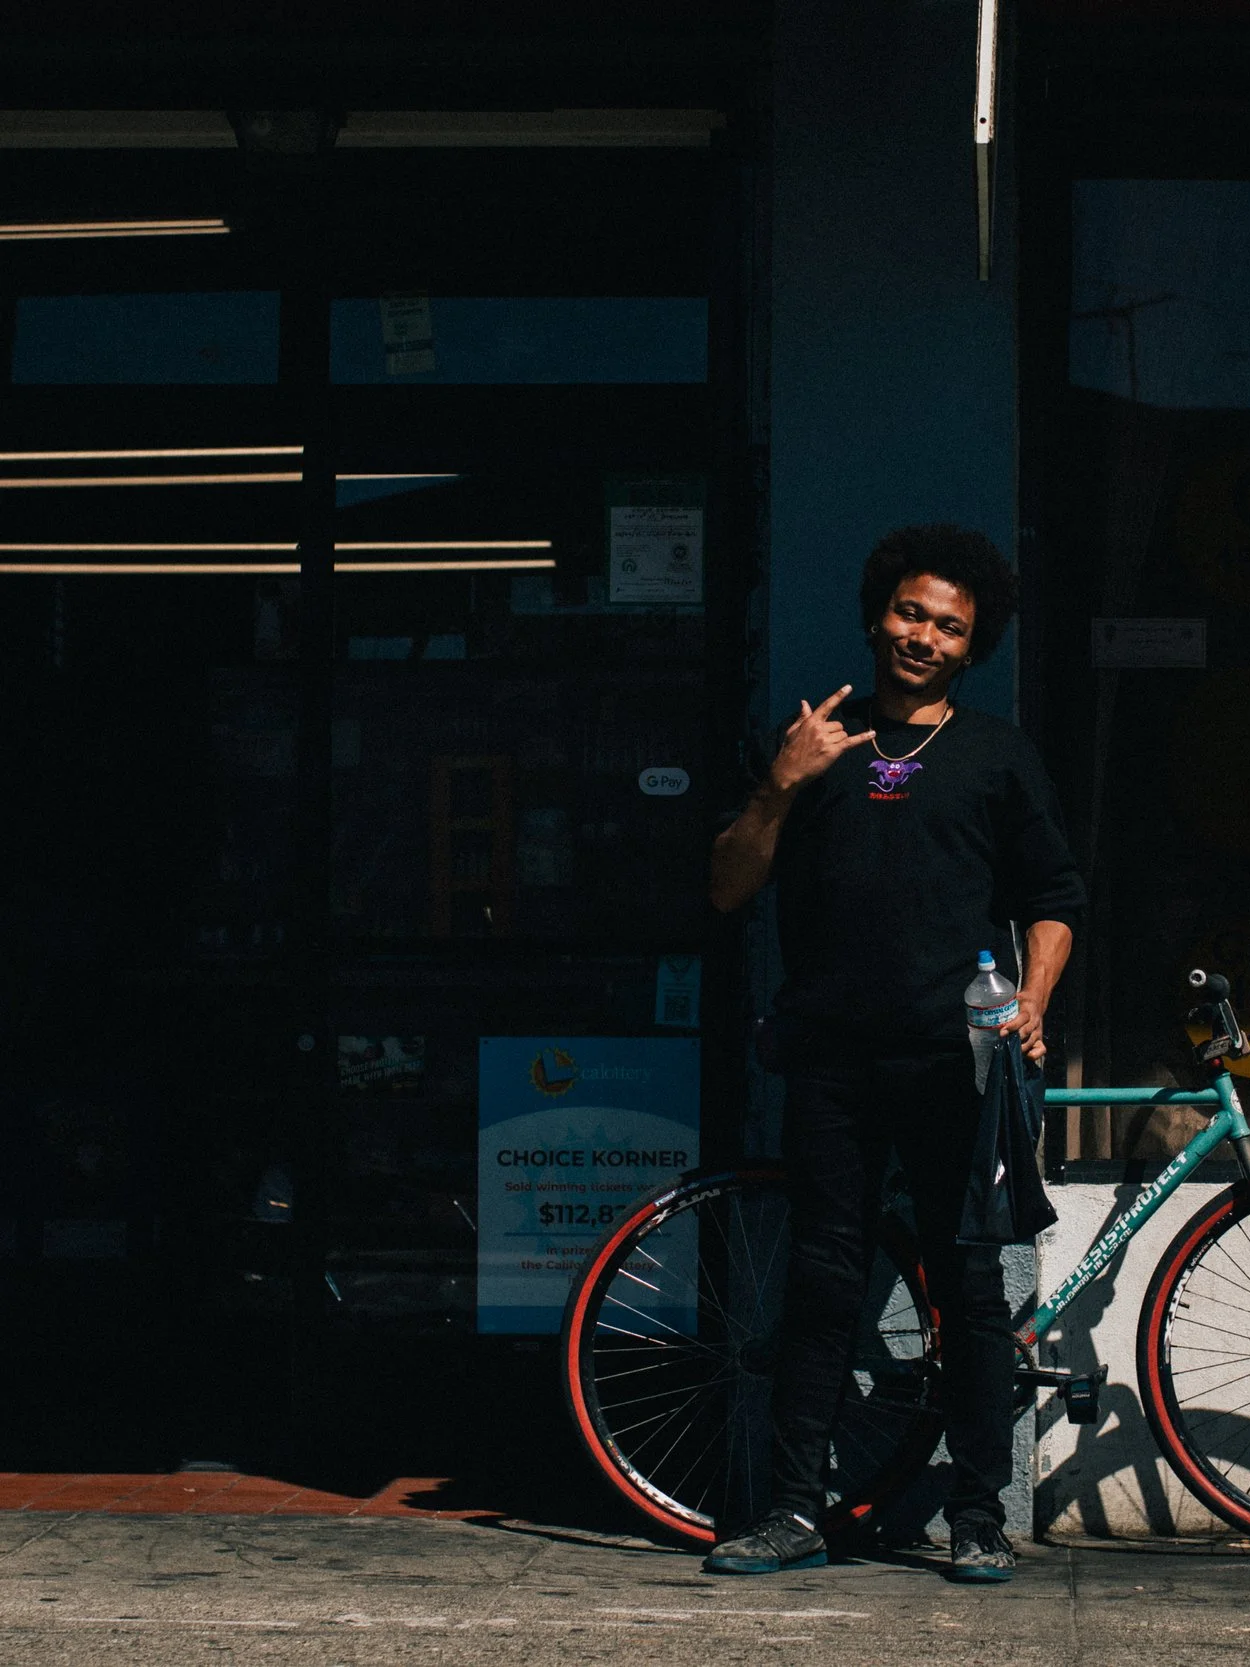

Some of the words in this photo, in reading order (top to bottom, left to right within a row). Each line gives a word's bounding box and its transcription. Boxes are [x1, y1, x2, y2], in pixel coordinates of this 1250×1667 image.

[496, 1150, 585, 1168] CHOICE
[591, 1150, 688, 1168] KORNER
[505, 1181, 532, 1192] Sold
[536, 1181, 586, 1194] winning
[591, 1182, 632, 1193] tickets
[521, 1260, 542, 1270] the
